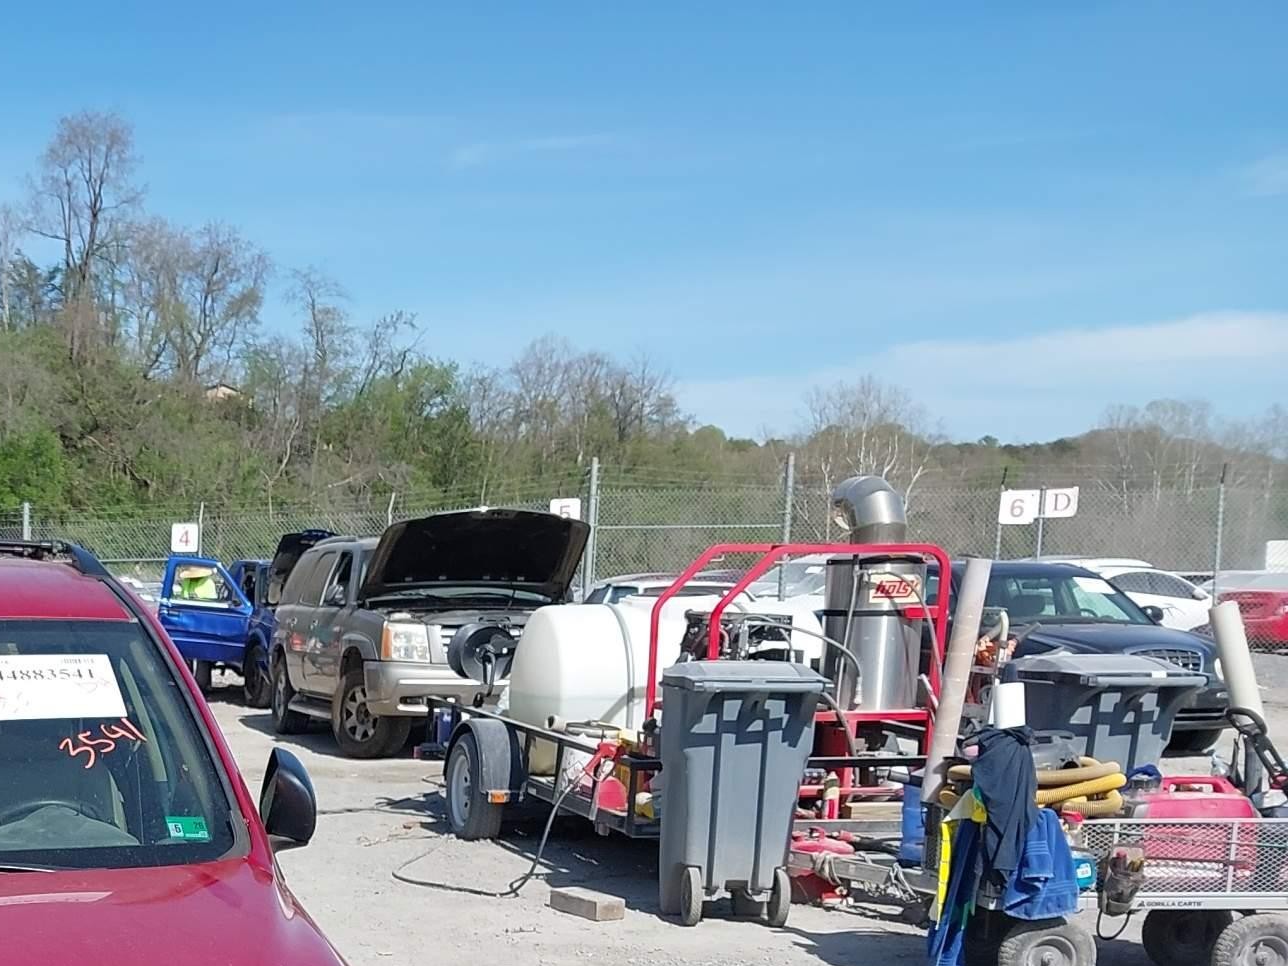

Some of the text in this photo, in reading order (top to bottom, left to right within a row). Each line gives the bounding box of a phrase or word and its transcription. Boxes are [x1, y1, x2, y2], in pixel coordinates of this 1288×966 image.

[1010, 498, 1025, 518] 6
[1053, 492, 1072, 512] D
[178, 529, 191, 547] 4
[59, 717, 148, 769] 3541
